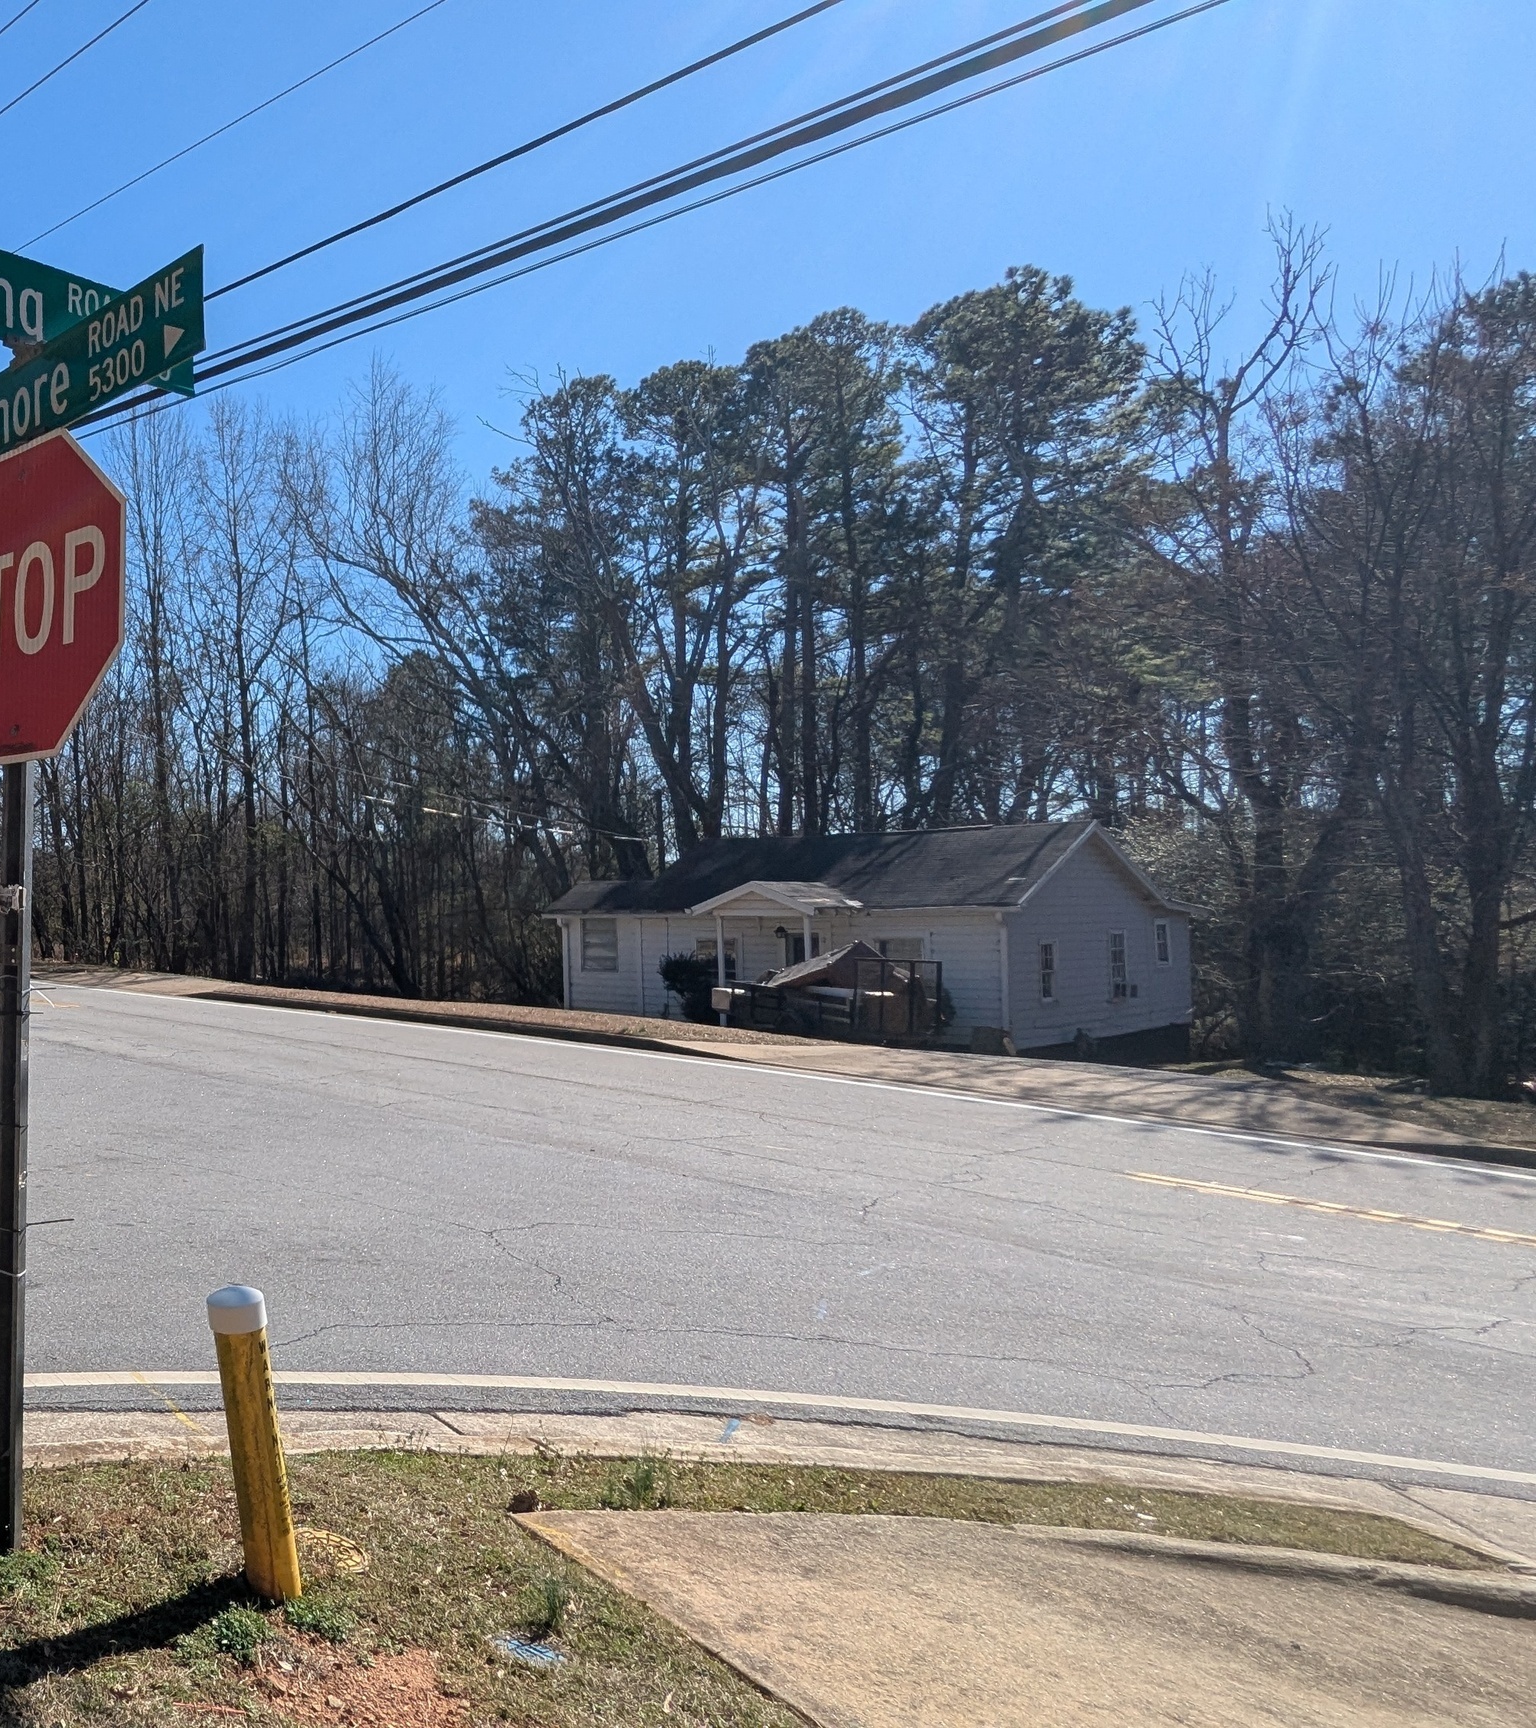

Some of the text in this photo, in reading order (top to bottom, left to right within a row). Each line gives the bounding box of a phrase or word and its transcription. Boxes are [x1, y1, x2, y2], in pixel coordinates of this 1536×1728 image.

[88, 268, 185, 358] ROAD NE
[89, 339, 145, 402] 5300
